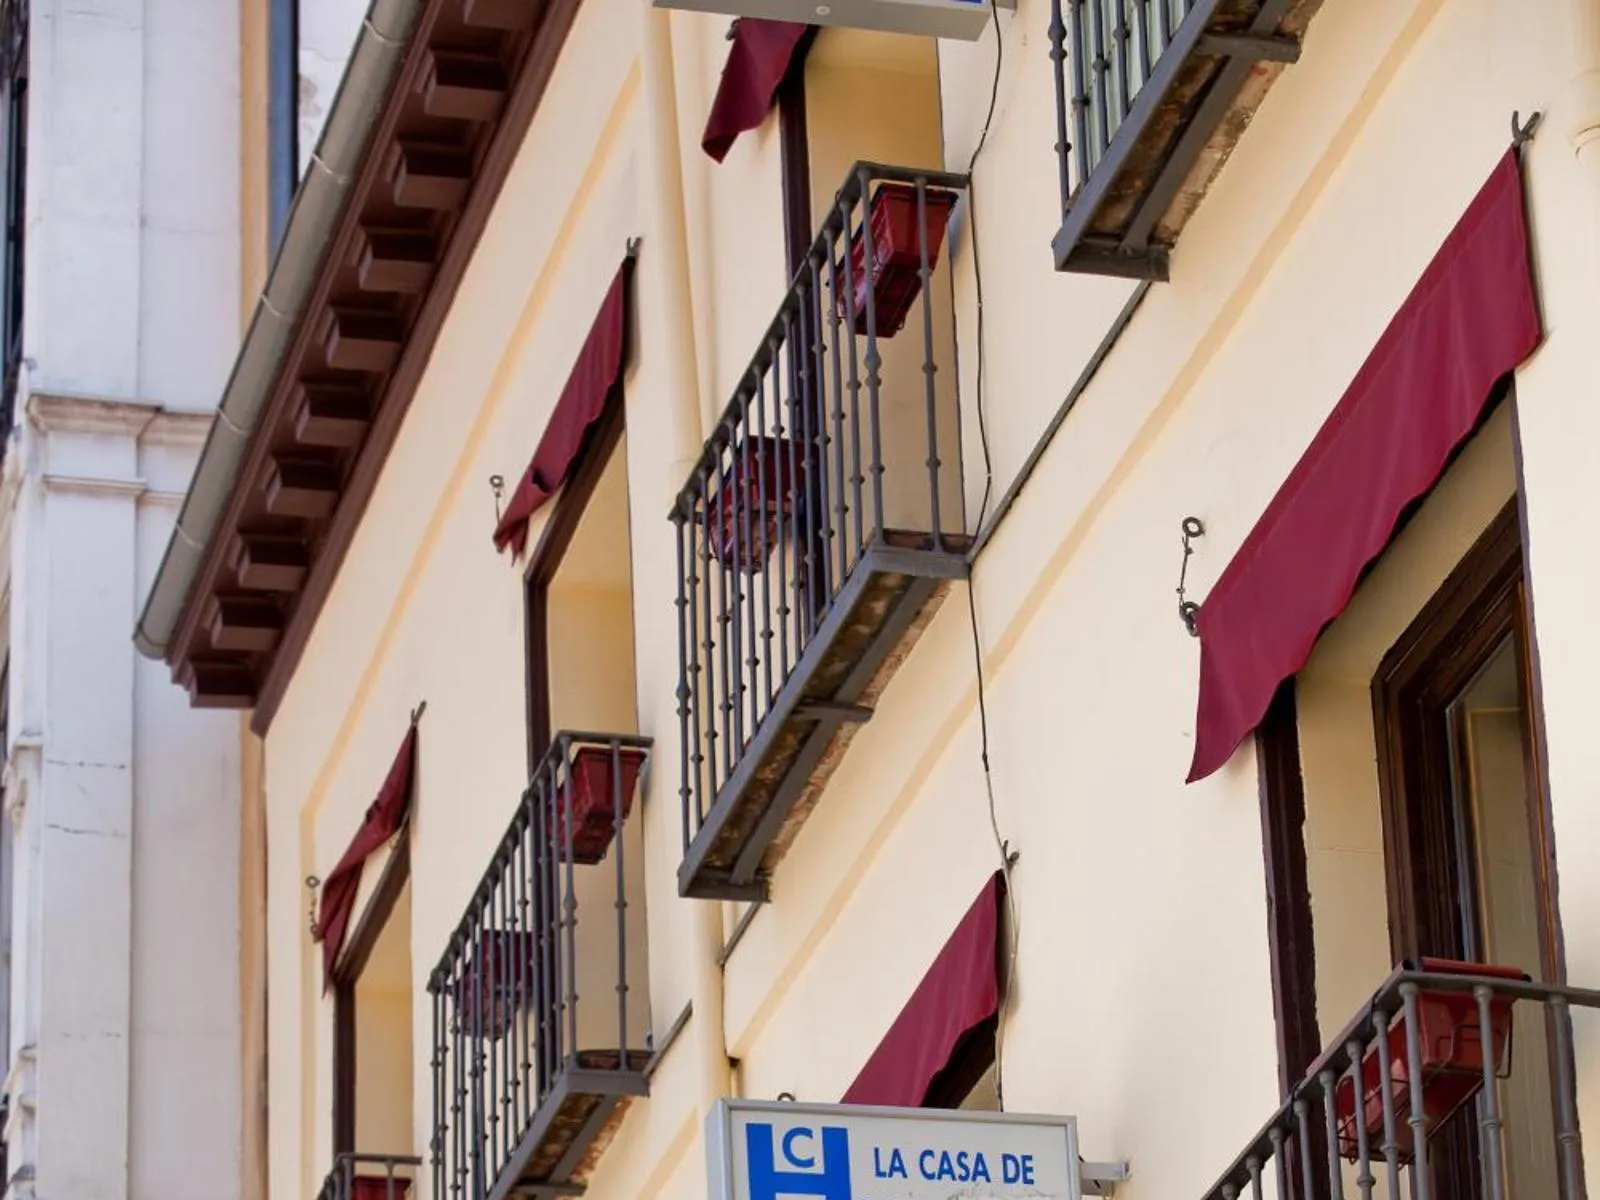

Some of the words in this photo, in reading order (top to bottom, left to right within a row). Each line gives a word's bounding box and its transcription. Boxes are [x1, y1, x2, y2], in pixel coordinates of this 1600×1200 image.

[874, 1148, 908, 1180] LA
[918, 1149, 991, 1184] CASA
[1001, 1154, 1035, 1186] DE
